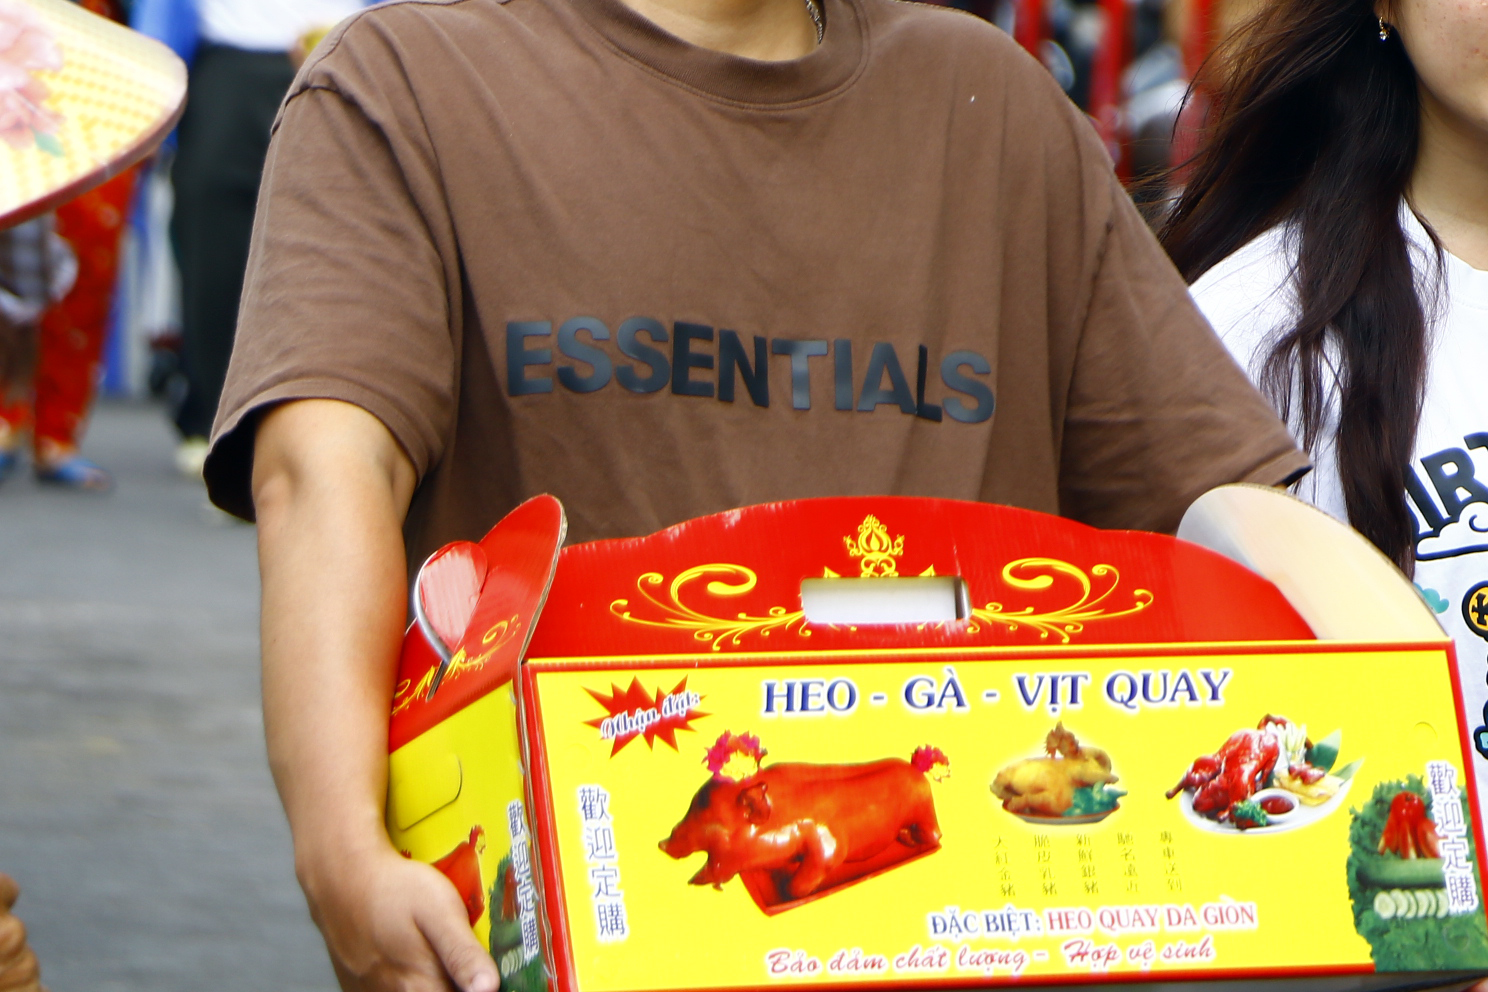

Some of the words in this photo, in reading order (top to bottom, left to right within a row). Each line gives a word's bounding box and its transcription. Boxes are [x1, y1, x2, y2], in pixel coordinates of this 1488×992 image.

[506, 315, 997, 424] ESSENTIALS
[764, 679, 857, 713] HEO
[904, 668, 967, 709] GÀ
[1016, 673, 1088, 713] VỊT
[1105, 670, 1230, 709] QUAY
[508, 804, 538, 954] 歡迎定購
[579, 787, 626, 936] 歡迎定購
[1429, 763, 1475, 906] 歡迎定購
[896, 946, 948, 969] chất
[958, 945, 1027, 972] lượng
[1064, 939, 1120, 968] Hợp
[1128, 942, 1155, 967] vệ
[1162, 936, 1213, 960] sinh
[931, 908, 979, 938] ĐẶC
[984, 906, 1041, 936] BIỆT:
[1048, 910, 1092, 931] HEO
[1099, 907, 1158, 931] QUAY
[1166, 906, 1197, 927] DA
